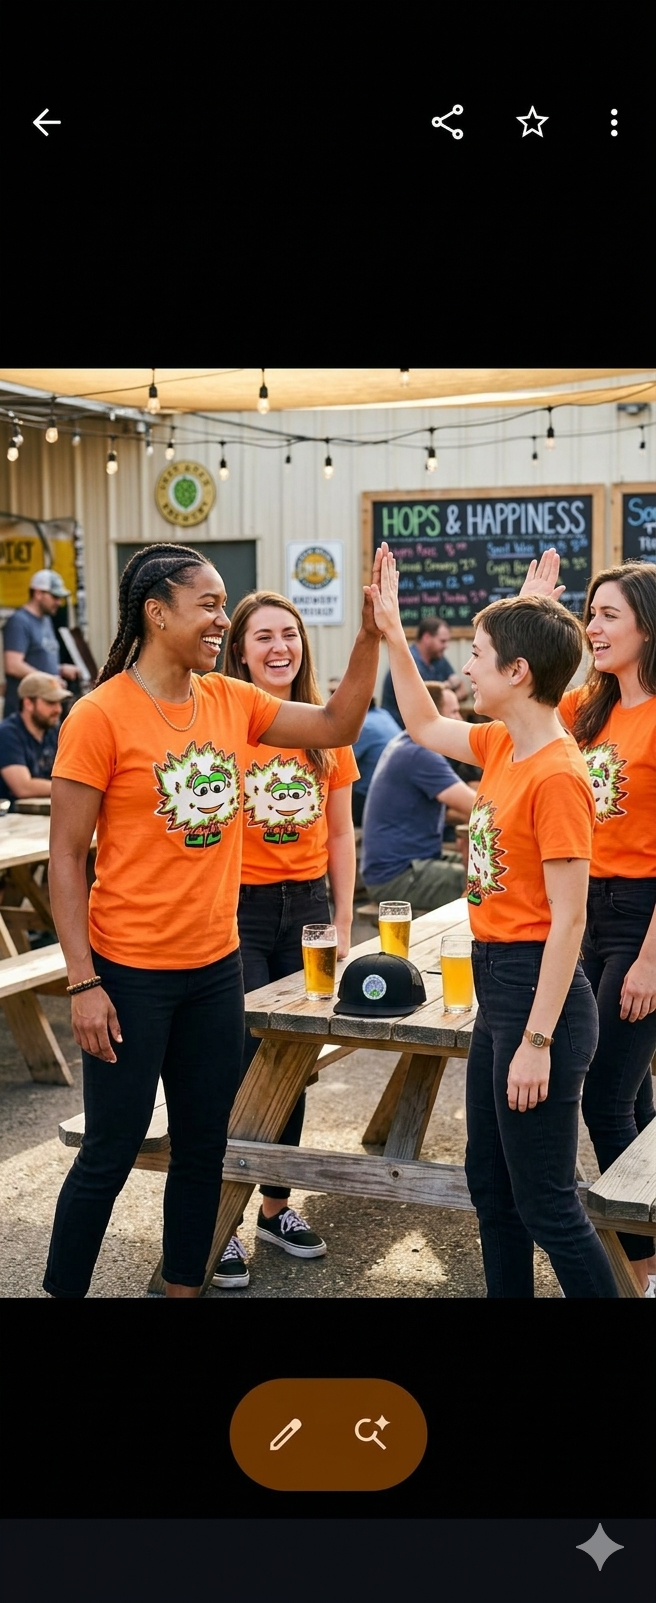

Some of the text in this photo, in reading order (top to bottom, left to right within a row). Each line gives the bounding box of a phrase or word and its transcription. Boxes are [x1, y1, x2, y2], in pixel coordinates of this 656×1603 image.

[382, 500, 586, 537] HOPS & HAPPINESS
